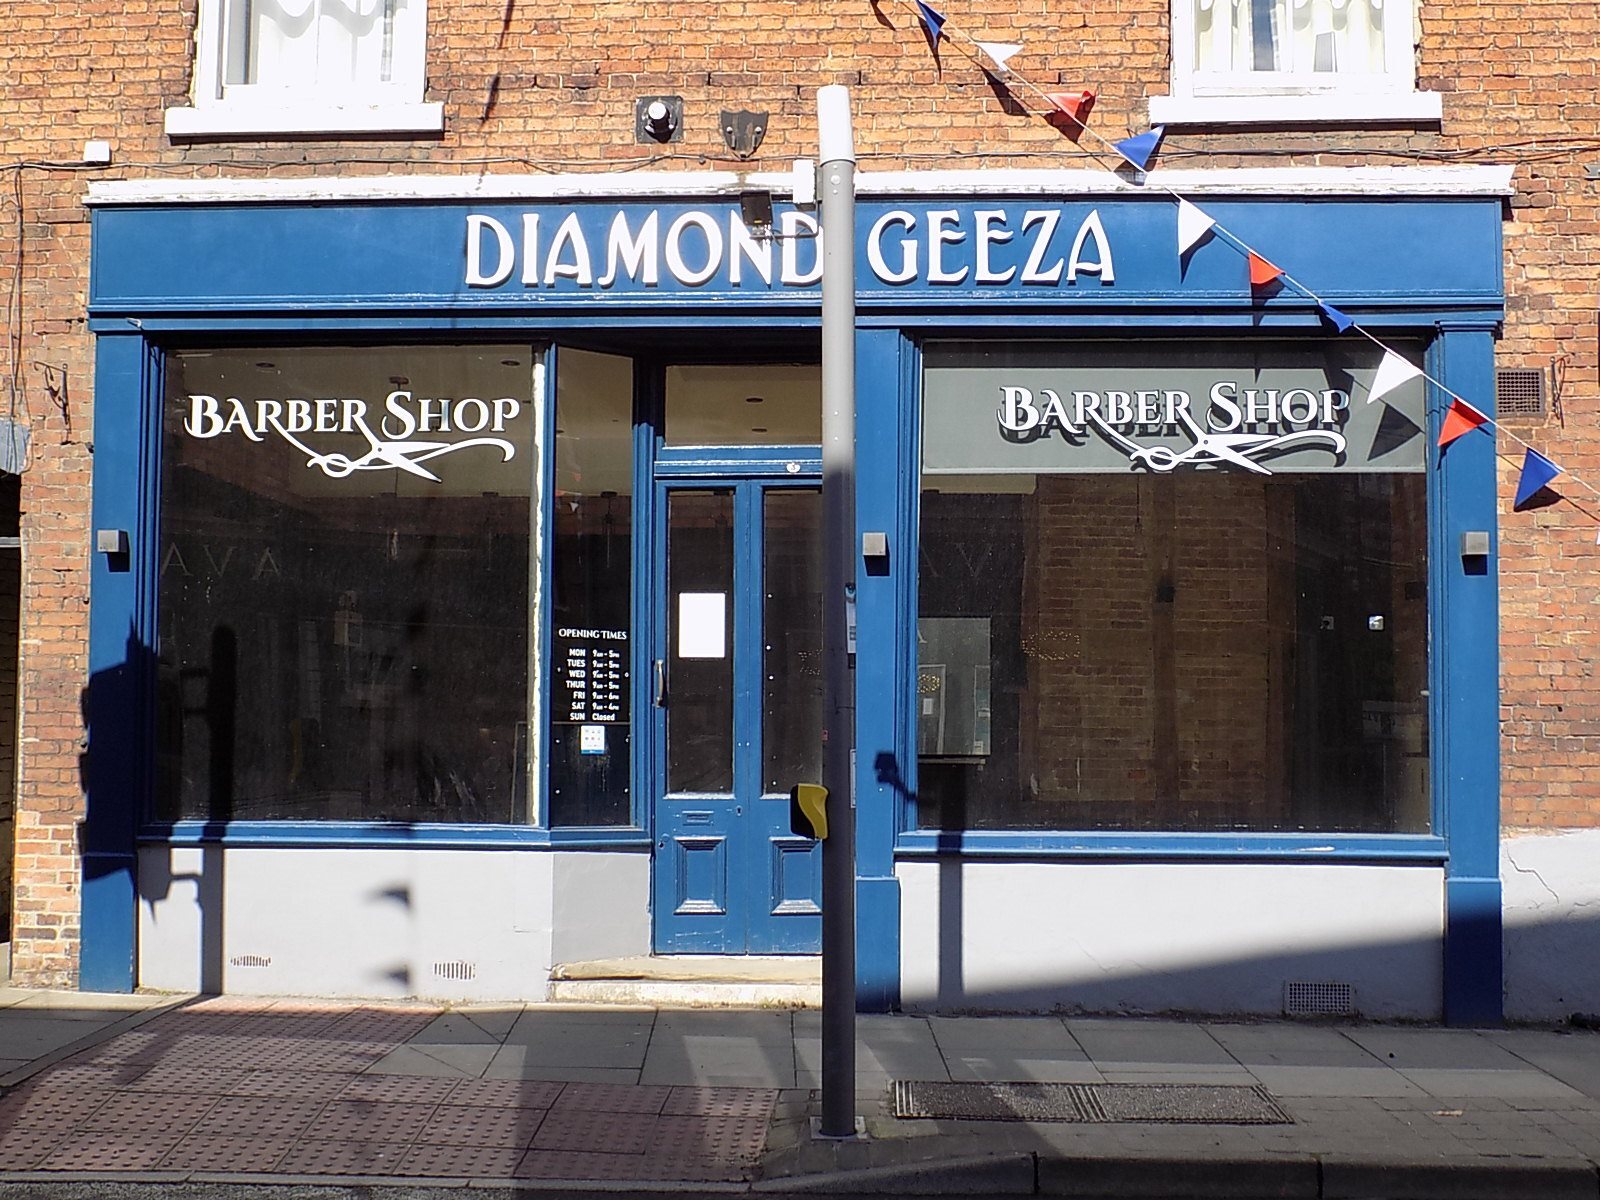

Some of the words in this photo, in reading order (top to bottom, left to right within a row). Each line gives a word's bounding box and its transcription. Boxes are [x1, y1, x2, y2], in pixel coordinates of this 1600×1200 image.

[465, 209, 823, 287] DIAMOND
[867, 209, 1115, 284] GEEZA
[997, 386, 1203, 434] BARBER
[1206, 381, 1350, 432] SHOP
[184, 394, 379, 442] BARBER
[381, 390, 520, 440] SHOP
[558, 628, 600, 639] OPENING
[600, 630, 627, 640] TIMES
[569, 648, 586, 657] MON
[567, 659, 586, 667] TUES
[568, 670, 586, 678] WED
[566, 680, 586, 688] THUR
[573, 691, 586, 699] FRI
[571, 702, 586, 710] SAT
[570, 712, 586, 720] SUN
[592, 713, 616, 721] Closed
